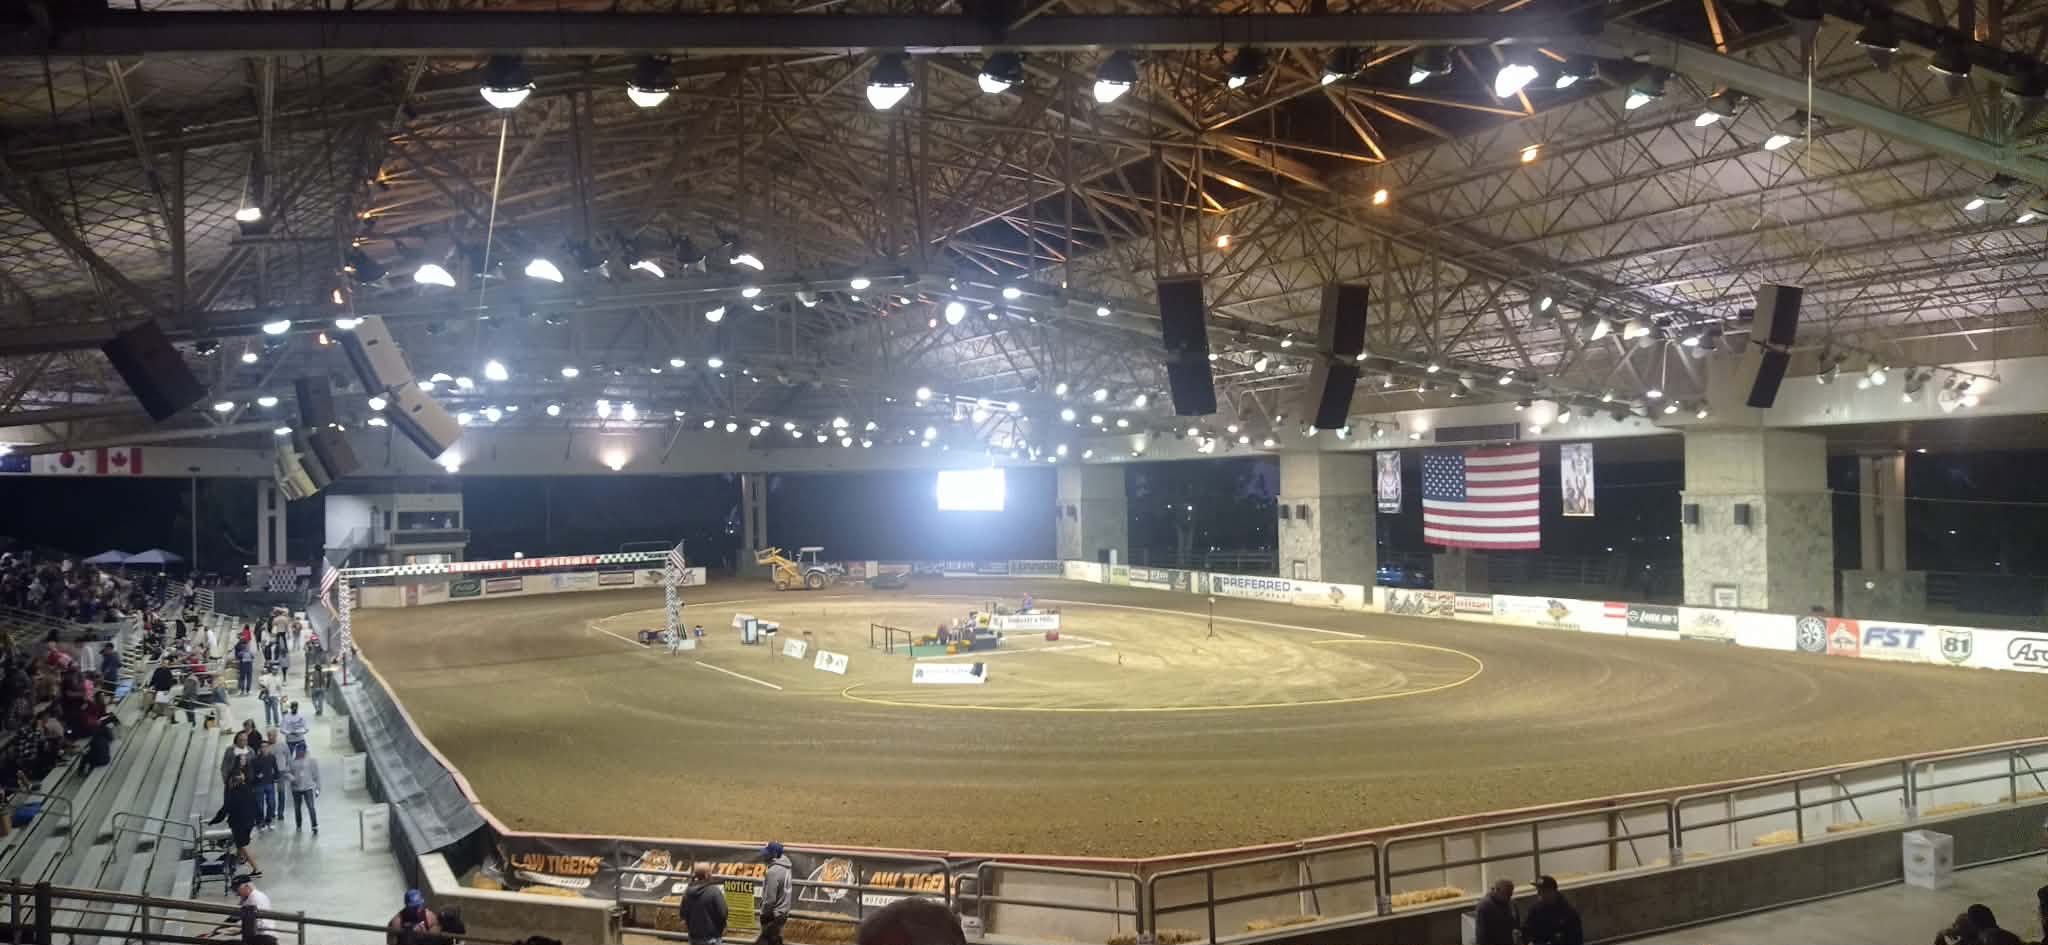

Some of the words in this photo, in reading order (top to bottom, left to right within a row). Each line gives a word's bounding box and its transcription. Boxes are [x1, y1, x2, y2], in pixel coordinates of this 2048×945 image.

[1223, 576, 1291, 592] PREFERRED
[1864, 626, 1924, 649] FST
[1944, 636, 1969, 652] 81
[511, 853, 545, 872] LAW
[546, 855, 602, 876] TIGERS
[725, 880, 753, 893] NOTICE
